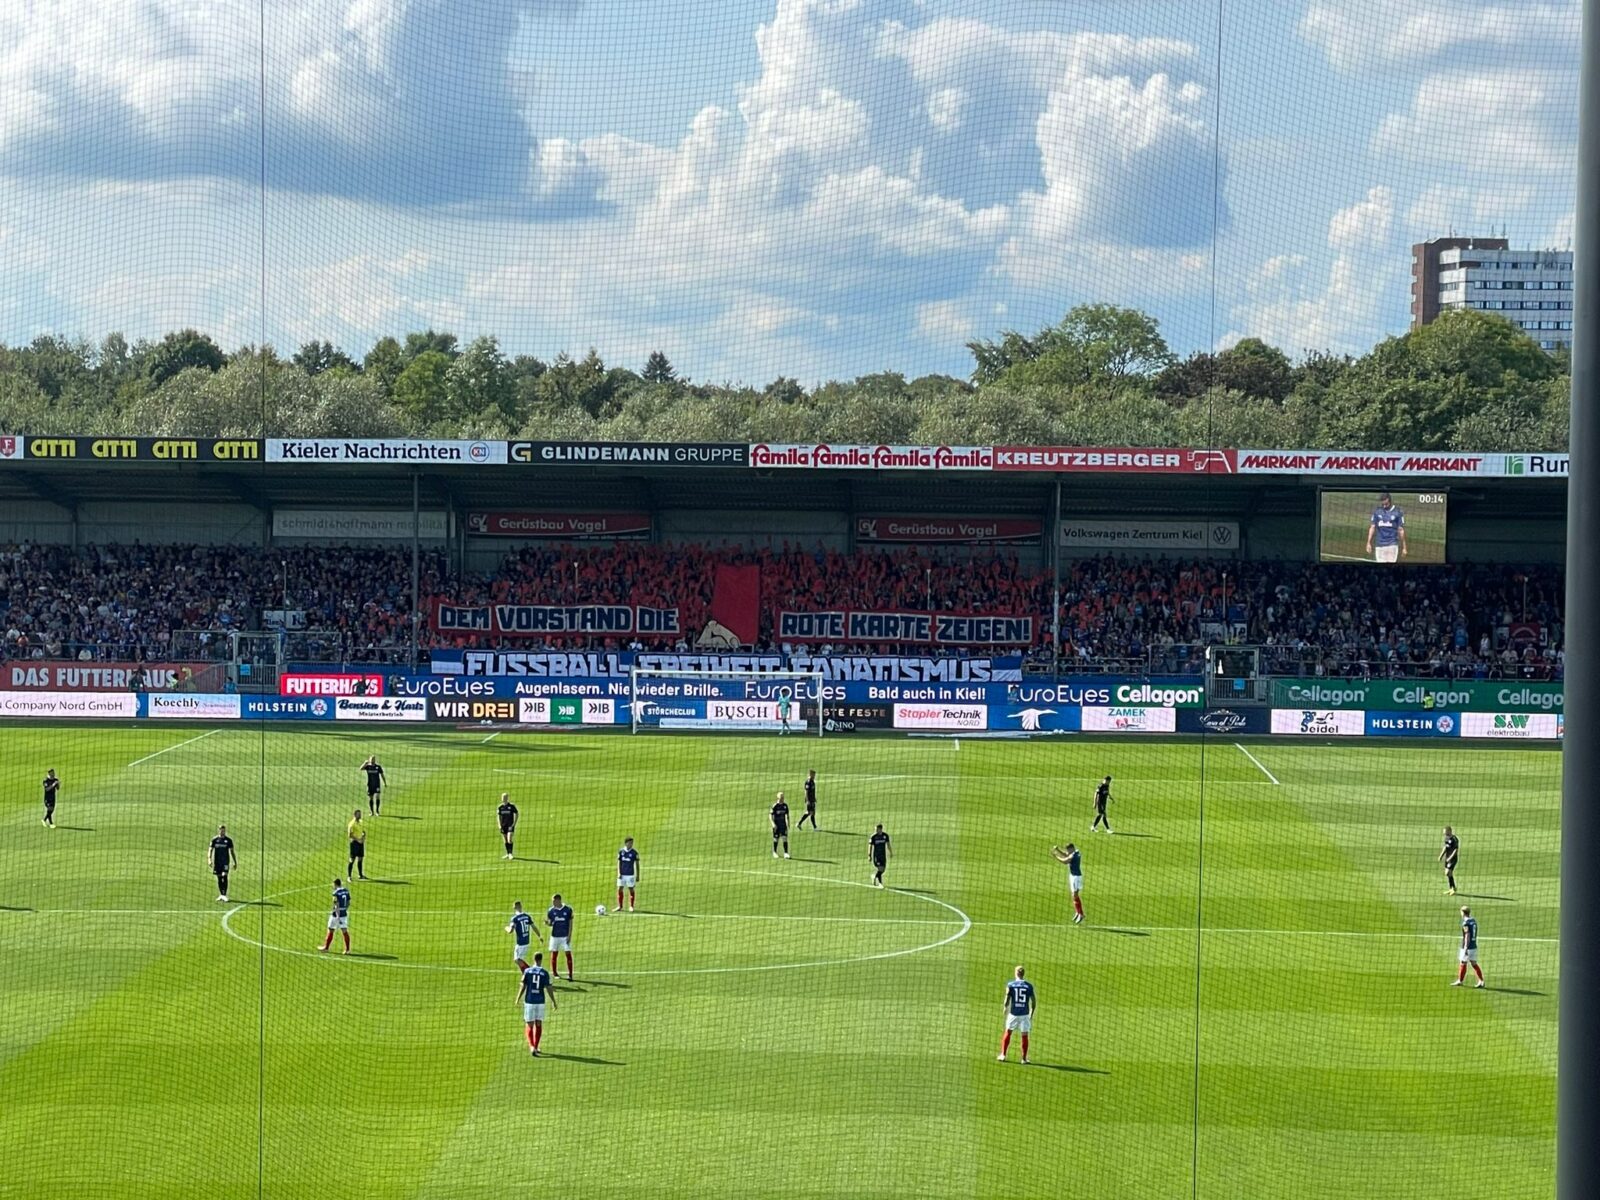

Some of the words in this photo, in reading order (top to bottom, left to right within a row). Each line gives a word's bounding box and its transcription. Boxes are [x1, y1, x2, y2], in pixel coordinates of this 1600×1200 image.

[31, 440, 75, 457] CITTI
[92, 440, 136, 458] CITTI
[152, 441, 197, 458] CITTI
[213, 442, 258, 459] CITTI
[282, 443, 338, 458] Kieler
[345, 444, 461, 460] Nachrichten
[542, 447, 669, 461] GLINDEMANN
[675, 448, 742, 461] GRUPPE
[751, 444, 809, 467] famila
[812, 445, 870, 467] famila
[872, 446, 930, 468] famila
[933, 447, 991, 469] famila
[996, 452, 1181, 468] KREUTZBERGER
[1241, 455, 1321, 469] MARKANT
[1321, 456, 1402, 471] MARKANT
[1402, 458, 1482, 471] MARKANT
[1419, 495, 1443, 503] 00:14
[499, 518, 564, 530] Gerüstbau
[568, 519, 606, 532] Vogel
[888, 523, 954, 535] Gerüstbau
[959, 524, 997, 537] Vogel
[1064, 528, 1129, 541] Volkswagen
[1132, 530, 1179, 539] Zentrum
[1183, 530, 1202, 540] Kiel
[440, 606, 490, 628] DEM
[495, 605, 632, 632] VORSTAND
[638, 608, 678, 632] DIE
[782, 612, 842, 637] ROTE
[850, 614, 930, 639] KARTE
[937, 618, 1031, 642] ZEIGEN!
[466, 653, 630, 678] FUSSBALL
[790, 657, 992, 682] FANATISMUS
[12, 668, 49, 686] DAS
[397, 678, 495, 697] EuroEyes
[515, 682, 604, 698] Augenlasern.
[608, 683, 630, 695] Nie
[636, 684, 681, 695] wieder
[684, 684, 723, 696] Brille.
[745, 682, 846, 700] EuroEyes
[869, 687, 900, 699] Bald
[903, 688, 937, 699] auch
[940, 688, 951, 699] in
[956, 688, 985, 700] Kiel!
[154, 697, 199, 708] Koechly
[1117, 686, 1199, 707] Cellagon
[1289, 687, 1365, 706] Cellagon
[5, 700, 56, 713] Company
[59, 701, 85, 710] Nord
[88, 701, 122, 711] GmbH
[249, 701, 307, 712] HOLSTEIN
[435, 702, 469, 718] WIR
[473, 703, 514, 718] DREI
[647, 706, 696, 716] STÖRCHECLUB
[715, 707, 767, 719] BUSCH
[849, 709, 886, 717] FESTE
[899, 709, 941, 720] Stapler
[943, 710, 981, 719] Technik
[1494, 715, 1530, 728] S&W
[1301, 723, 1338, 733] Seidel
[1372, 719, 1432, 729] HOLSTEIN
[520, 919, 530, 933] 16
[532, 975, 541, 989] 4
[1014, 988, 1027, 1003] 15
